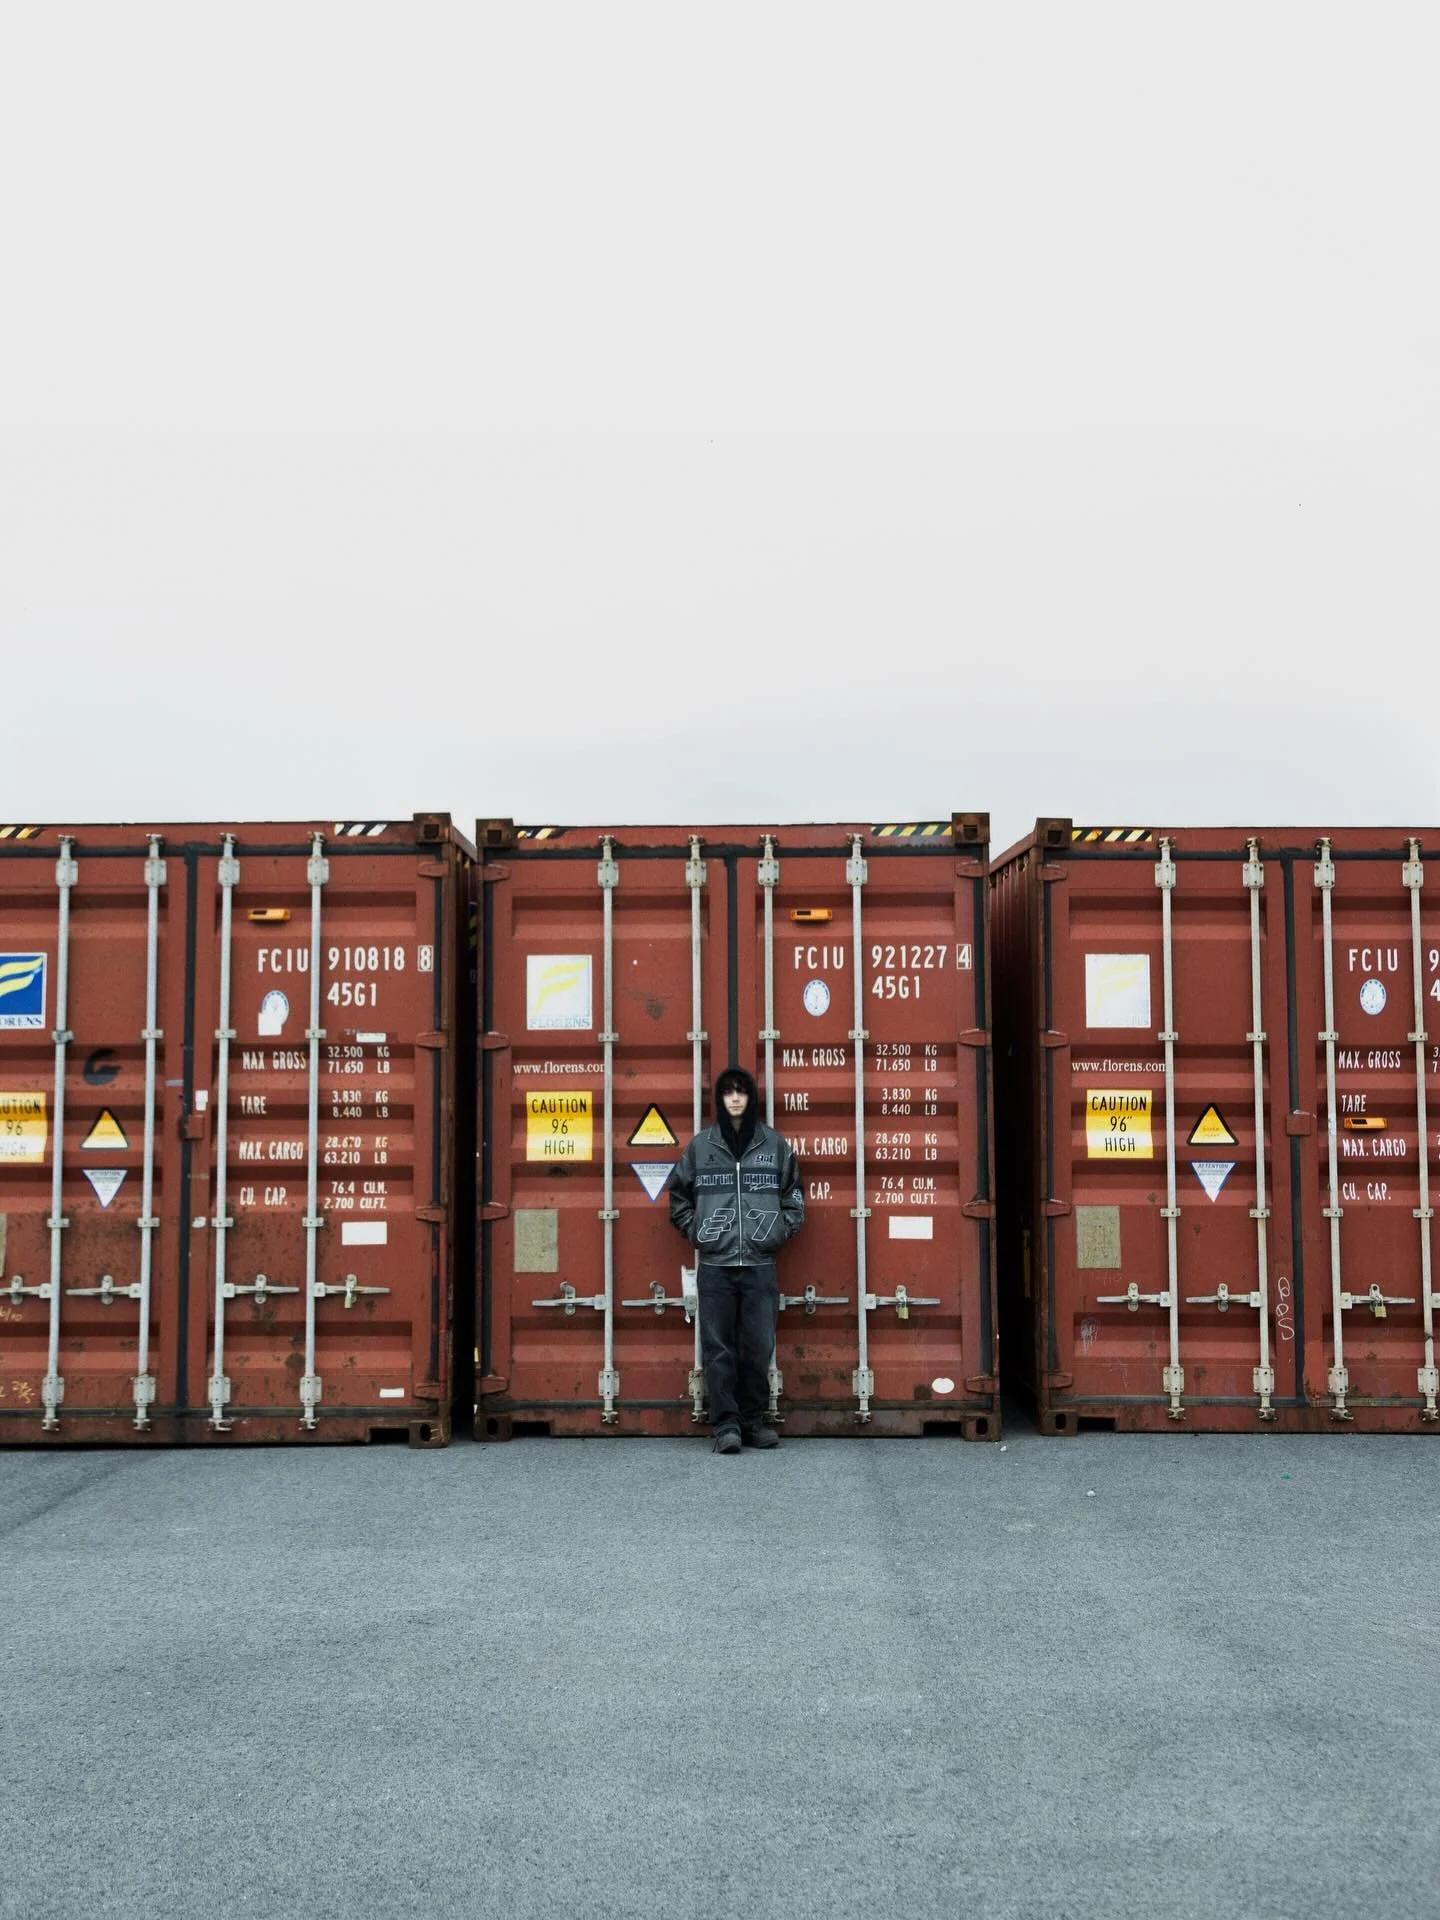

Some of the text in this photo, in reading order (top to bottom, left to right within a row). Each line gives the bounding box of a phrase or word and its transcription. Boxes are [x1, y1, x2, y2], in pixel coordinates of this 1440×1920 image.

[258, 946, 431, 973] FCIU 910818 8
[794, 945, 970, 969] FCIU 921227 4
[1349, 948, 1398, 972] FCIU
[327, 982, 377, 1007] 45G1
[872, 975, 920, 999] 45G1
[377, 1046, 390, 1058] KG
[783, 1048, 845, 1067] MAX. GROSS
[925, 1044, 937, 1056] KG
[272, 1051, 307, 1070] GROSS
[328, 1061, 390, 1073] 71.650 LB
[924, 1059, 937, 1071] LB
[1338, 1050, 1401, 1069] MAX. GROSS
[332, 1090, 388, 1103] 3.830 KG
[784, 1093, 809, 1111] TARE
[882, 1088, 938, 1101] 3.830 KG
[240, 1095, 267, 1115] TARE
[531, 1098, 587, 1113] CAUTION
[924, 1104, 937, 1116] LB
[1091, 1096, 1147, 1111] CAUTION
[1341, 1094, 1366, 1113] TARE
[332, 1106, 389, 1118] 8.440 LB
[325, 1136, 388, 1149] 28.670 KG
[925, 1132, 937, 1144] KG
[1104, 1137, 1135, 1152] HIGH
[239, 1141, 304, 1160] MAX. CARGO
[544, 1139, 575, 1155] HIGH
[814, 1137, 848, 1155] CARGO
[1342, 1138, 1406, 1157] MAX. CARGO
[324, 1151, 387, 1164] 63.210 LB
[925, 1149, 937, 1161] LB
[332, 1181, 355, 1194] 76.4
[810, 1182, 833, 1200] CAP.
[881, 1177, 936, 1190] 76.4 CU.M.
[240, 1187, 288, 1206] CU. CAP.
[875, 1192, 904, 1204] 2.700
[1342, 1182, 1391, 1201] CU. CAP.
[324, 1197, 354, 1209] 2.700
